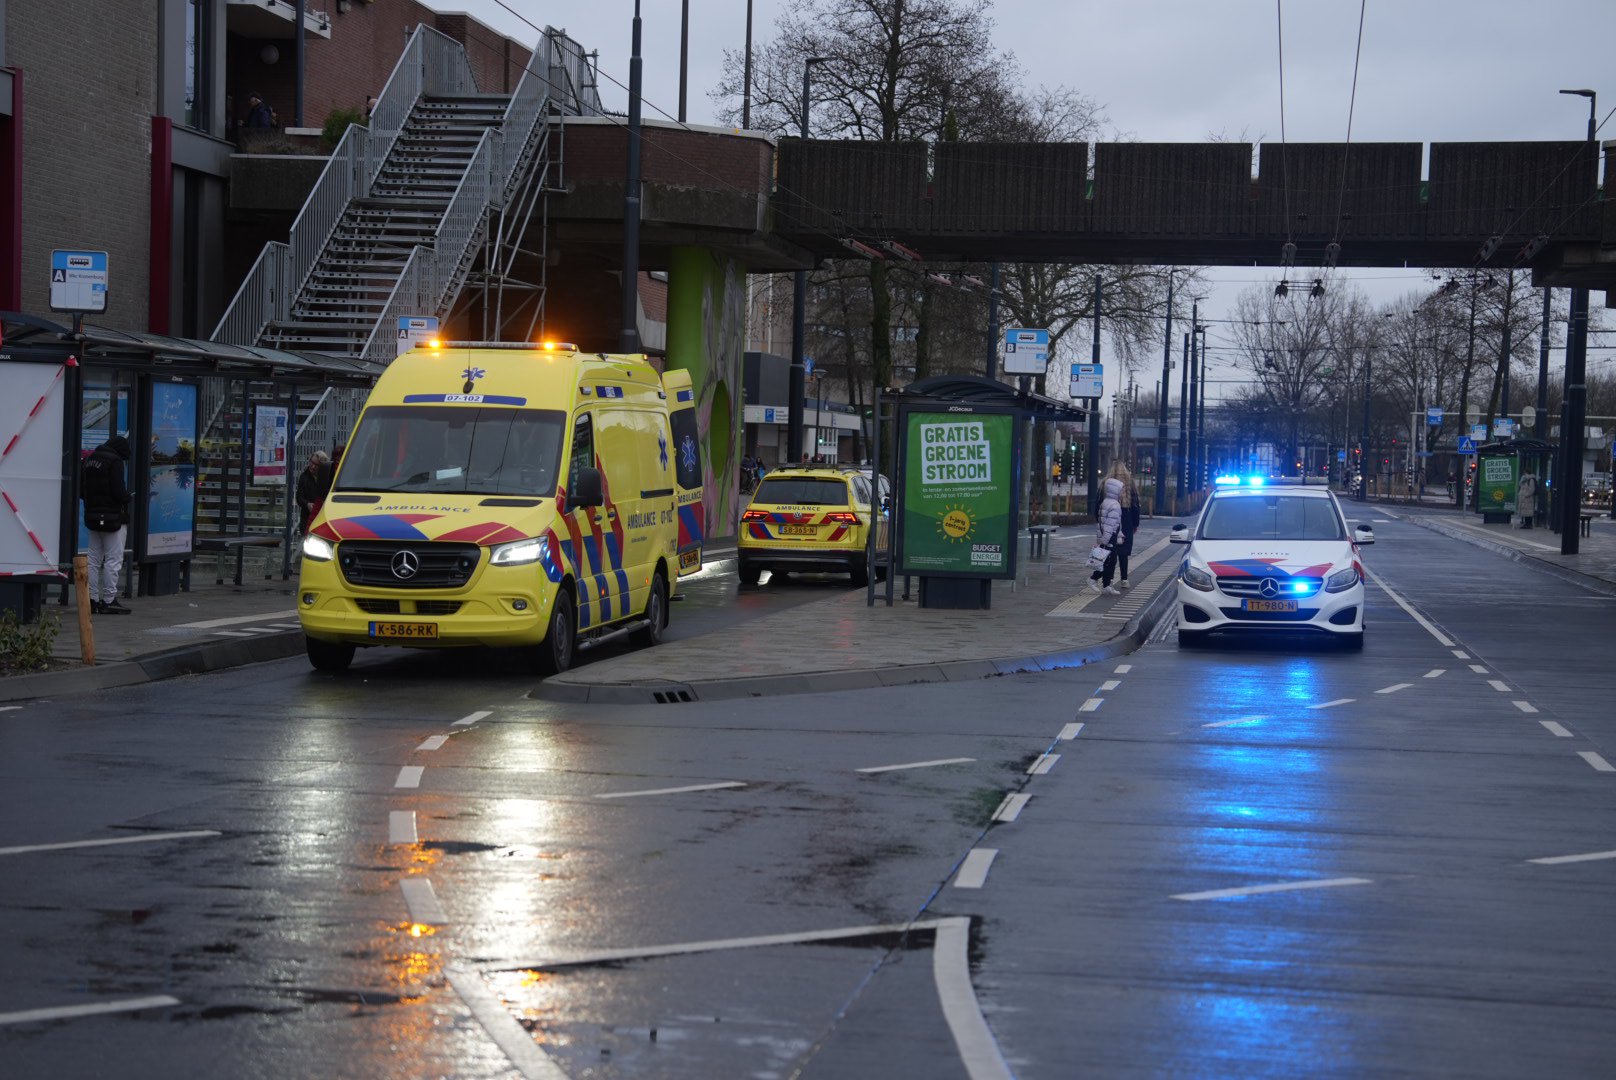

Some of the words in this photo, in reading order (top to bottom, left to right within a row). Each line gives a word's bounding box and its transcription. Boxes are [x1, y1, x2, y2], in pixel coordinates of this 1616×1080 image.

[53, 269, 65, 281] A
[399, 329, 407, 338] A
[1007, 343, 1015, 352] B
[1071, 374, 1079, 382] B
[924, 426, 980, 443] GRATIS
[925, 444, 987, 462] GROENE
[926, 463, 987, 480] STROOM
[678, 490, 702, 503] MBULANCE
[373, 505, 471, 513] AMBULANCE
[627, 511, 656, 530] AMBULANCE
[972, 544, 1001, 552] BUDGET
[972, 553, 1001, 561] ENERGIE
[1250, 601, 1295, 610] TT-980-N
[378, 624, 434, 636] K-586-RK
